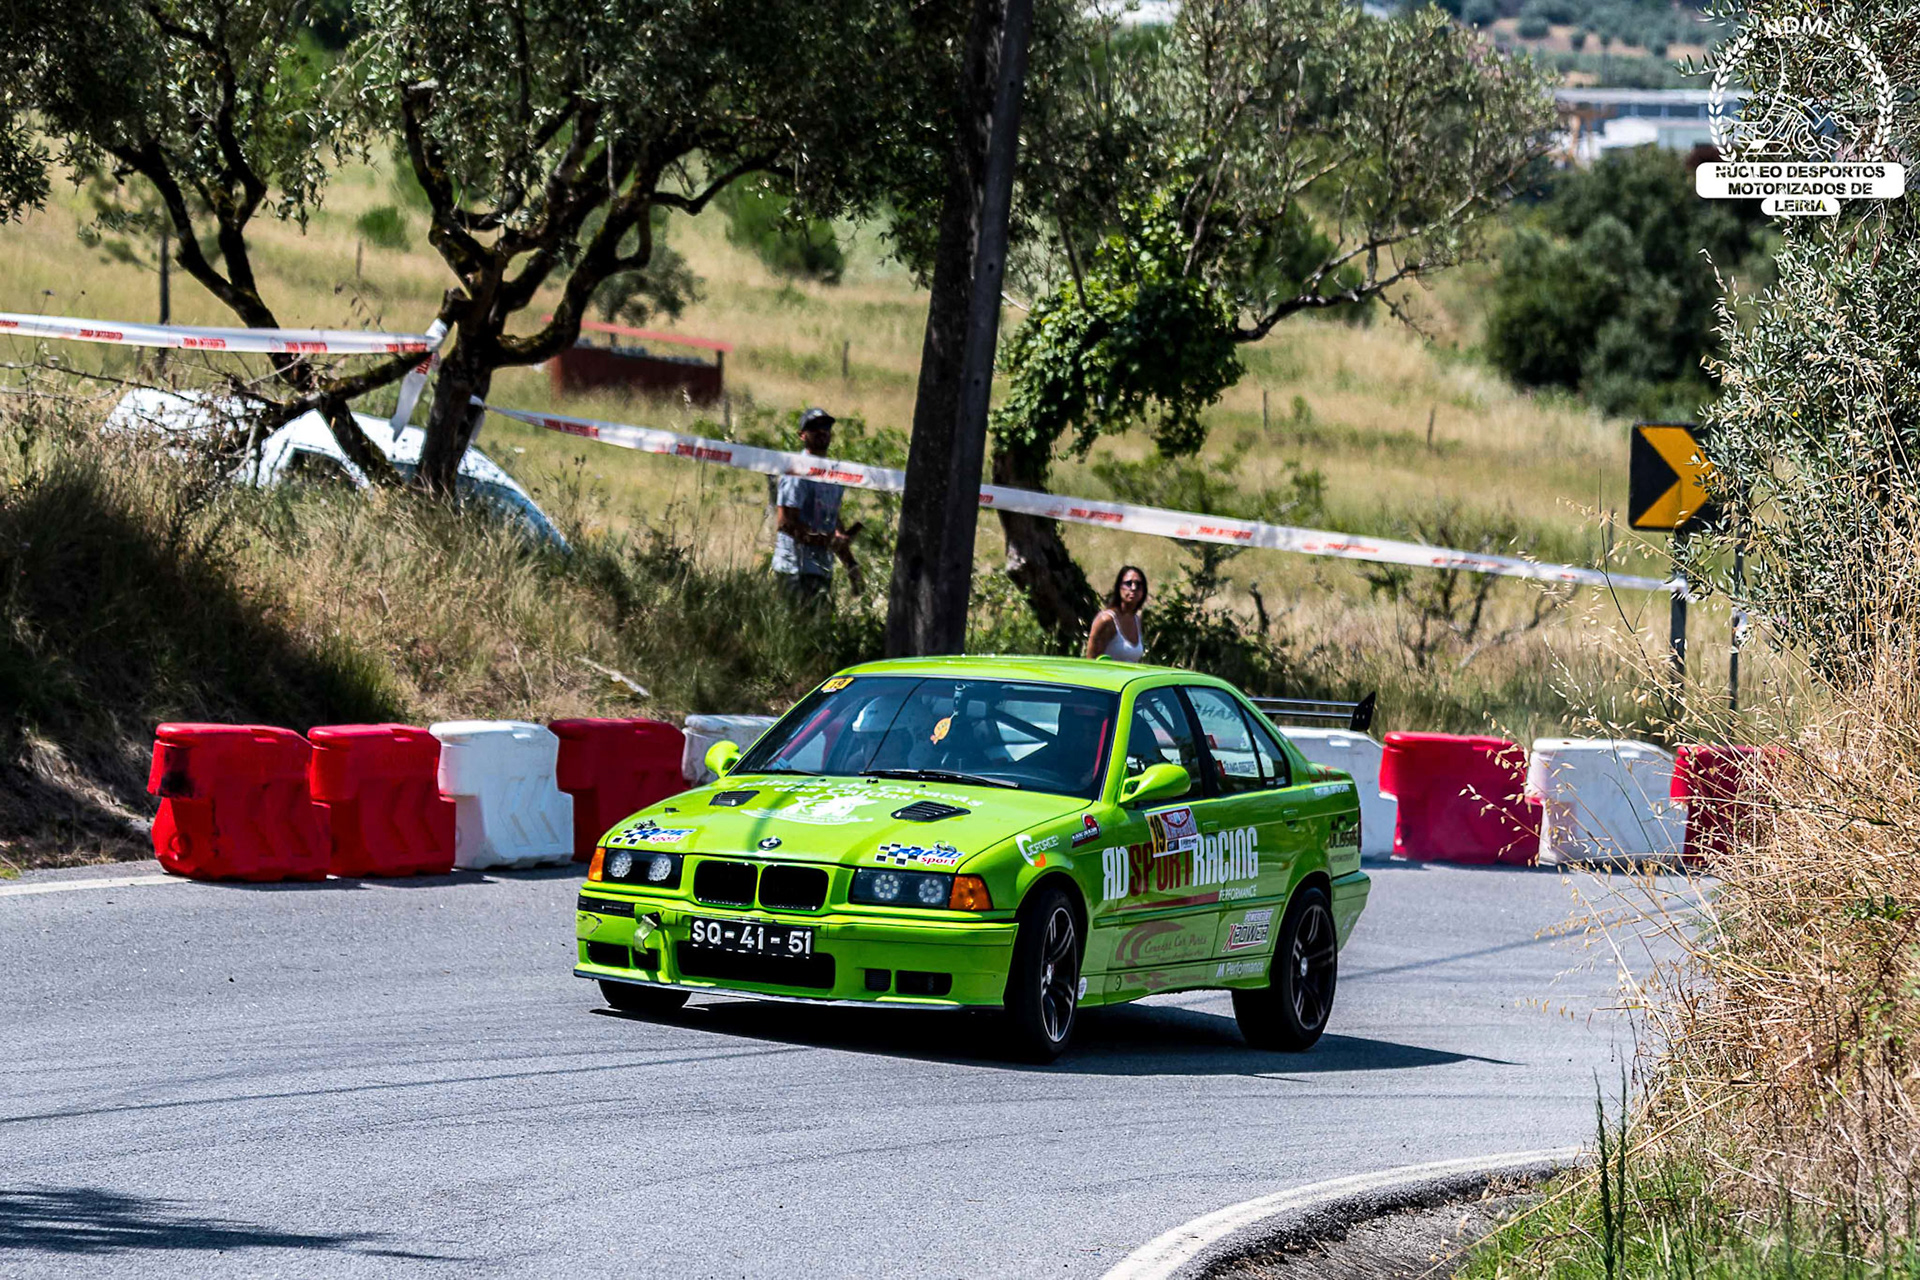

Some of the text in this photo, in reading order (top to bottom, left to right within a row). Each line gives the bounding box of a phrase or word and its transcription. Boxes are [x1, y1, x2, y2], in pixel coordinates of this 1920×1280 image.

[921, 857, 956, 866] sport
[1218, 884, 1257, 901] PERFORMANCE
[1226, 961, 1264, 976] Performance
